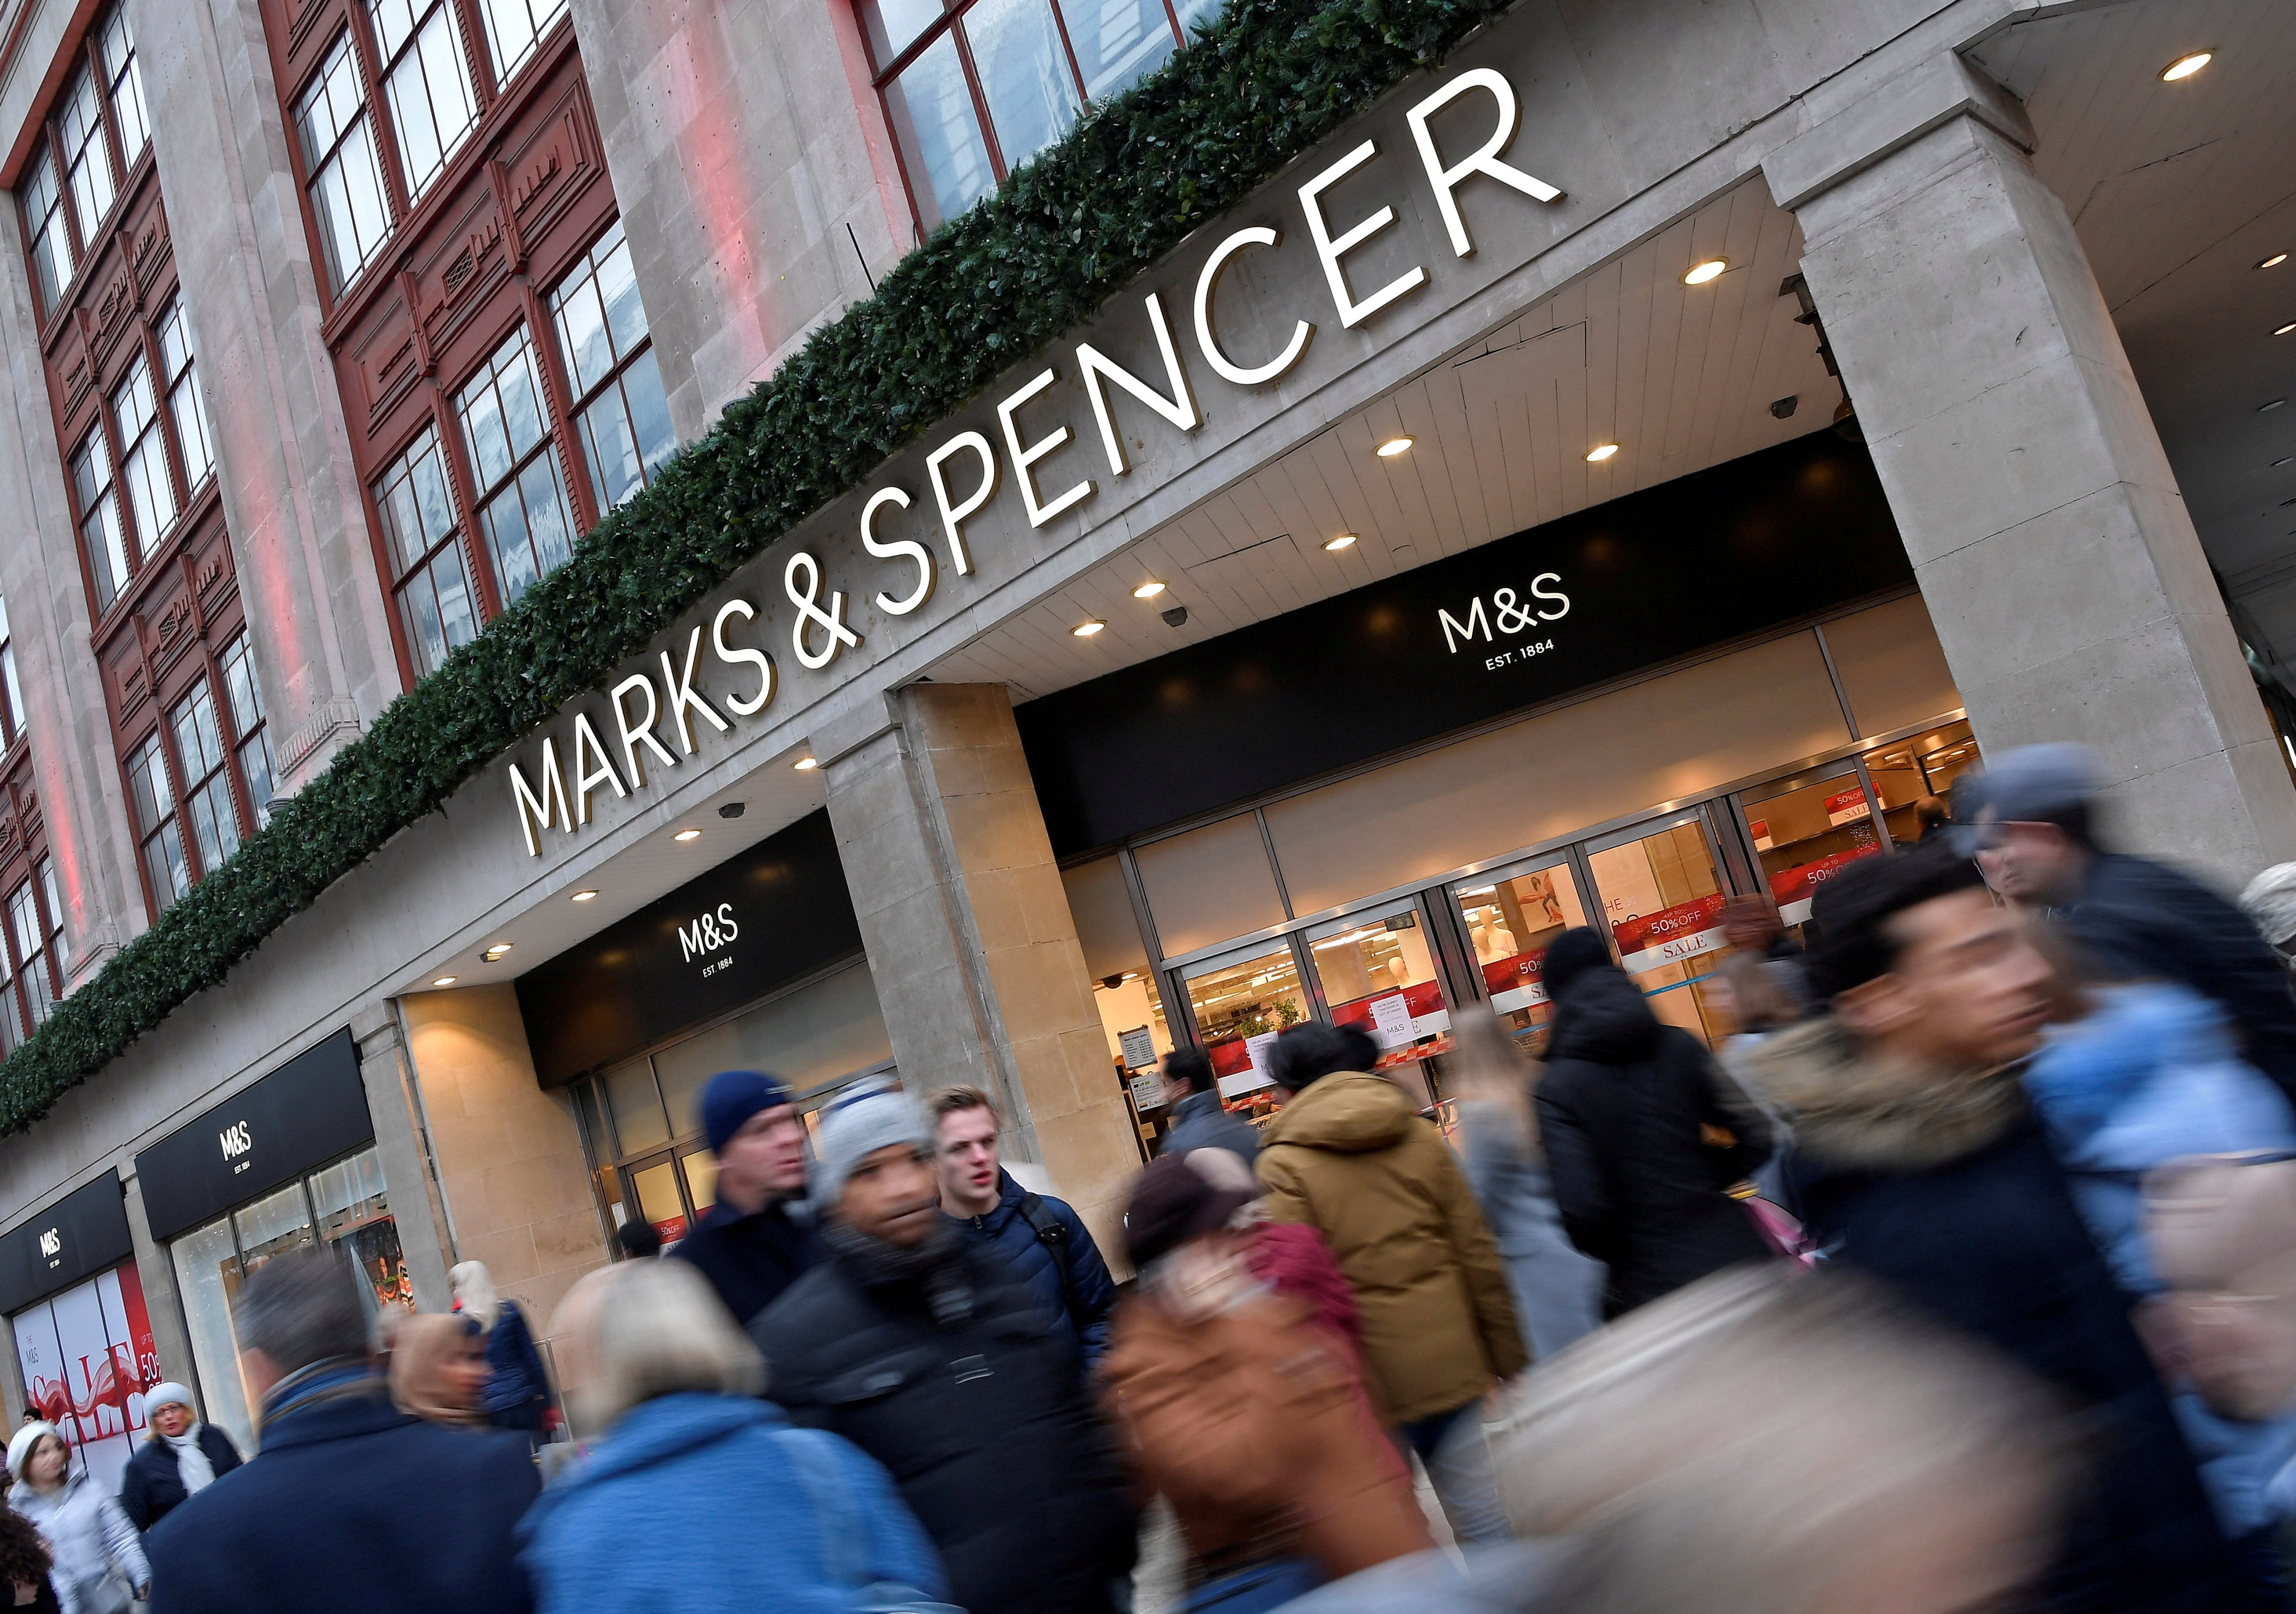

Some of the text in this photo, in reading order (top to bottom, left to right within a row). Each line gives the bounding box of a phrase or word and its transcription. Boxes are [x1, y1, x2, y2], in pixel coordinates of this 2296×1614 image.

[509, 67, 1568, 857] MARKS & SPENCER
[1438, 572, 1570, 654] M&S
[1485, 639, 1554, 671] EST. 1884
[1845, 804, 1869, 819] SALE
[1807, 868, 1835, 884] 50%
[1604, 898, 1623, 914] HE
[678, 903, 738, 963] M&S
[1651, 919, 1679, 934] 50%
[1679, 910, 1701, 925] OFF
[1663, 934, 1707, 958] SALE
[703, 956, 733, 978] EST. 1884
[1387, 1023, 1405, 1035] M&S
[219, 1120, 252, 1161] M&S
[40, 1227, 61, 1258] M&S
[26, 1346, 39, 1365] M&S
